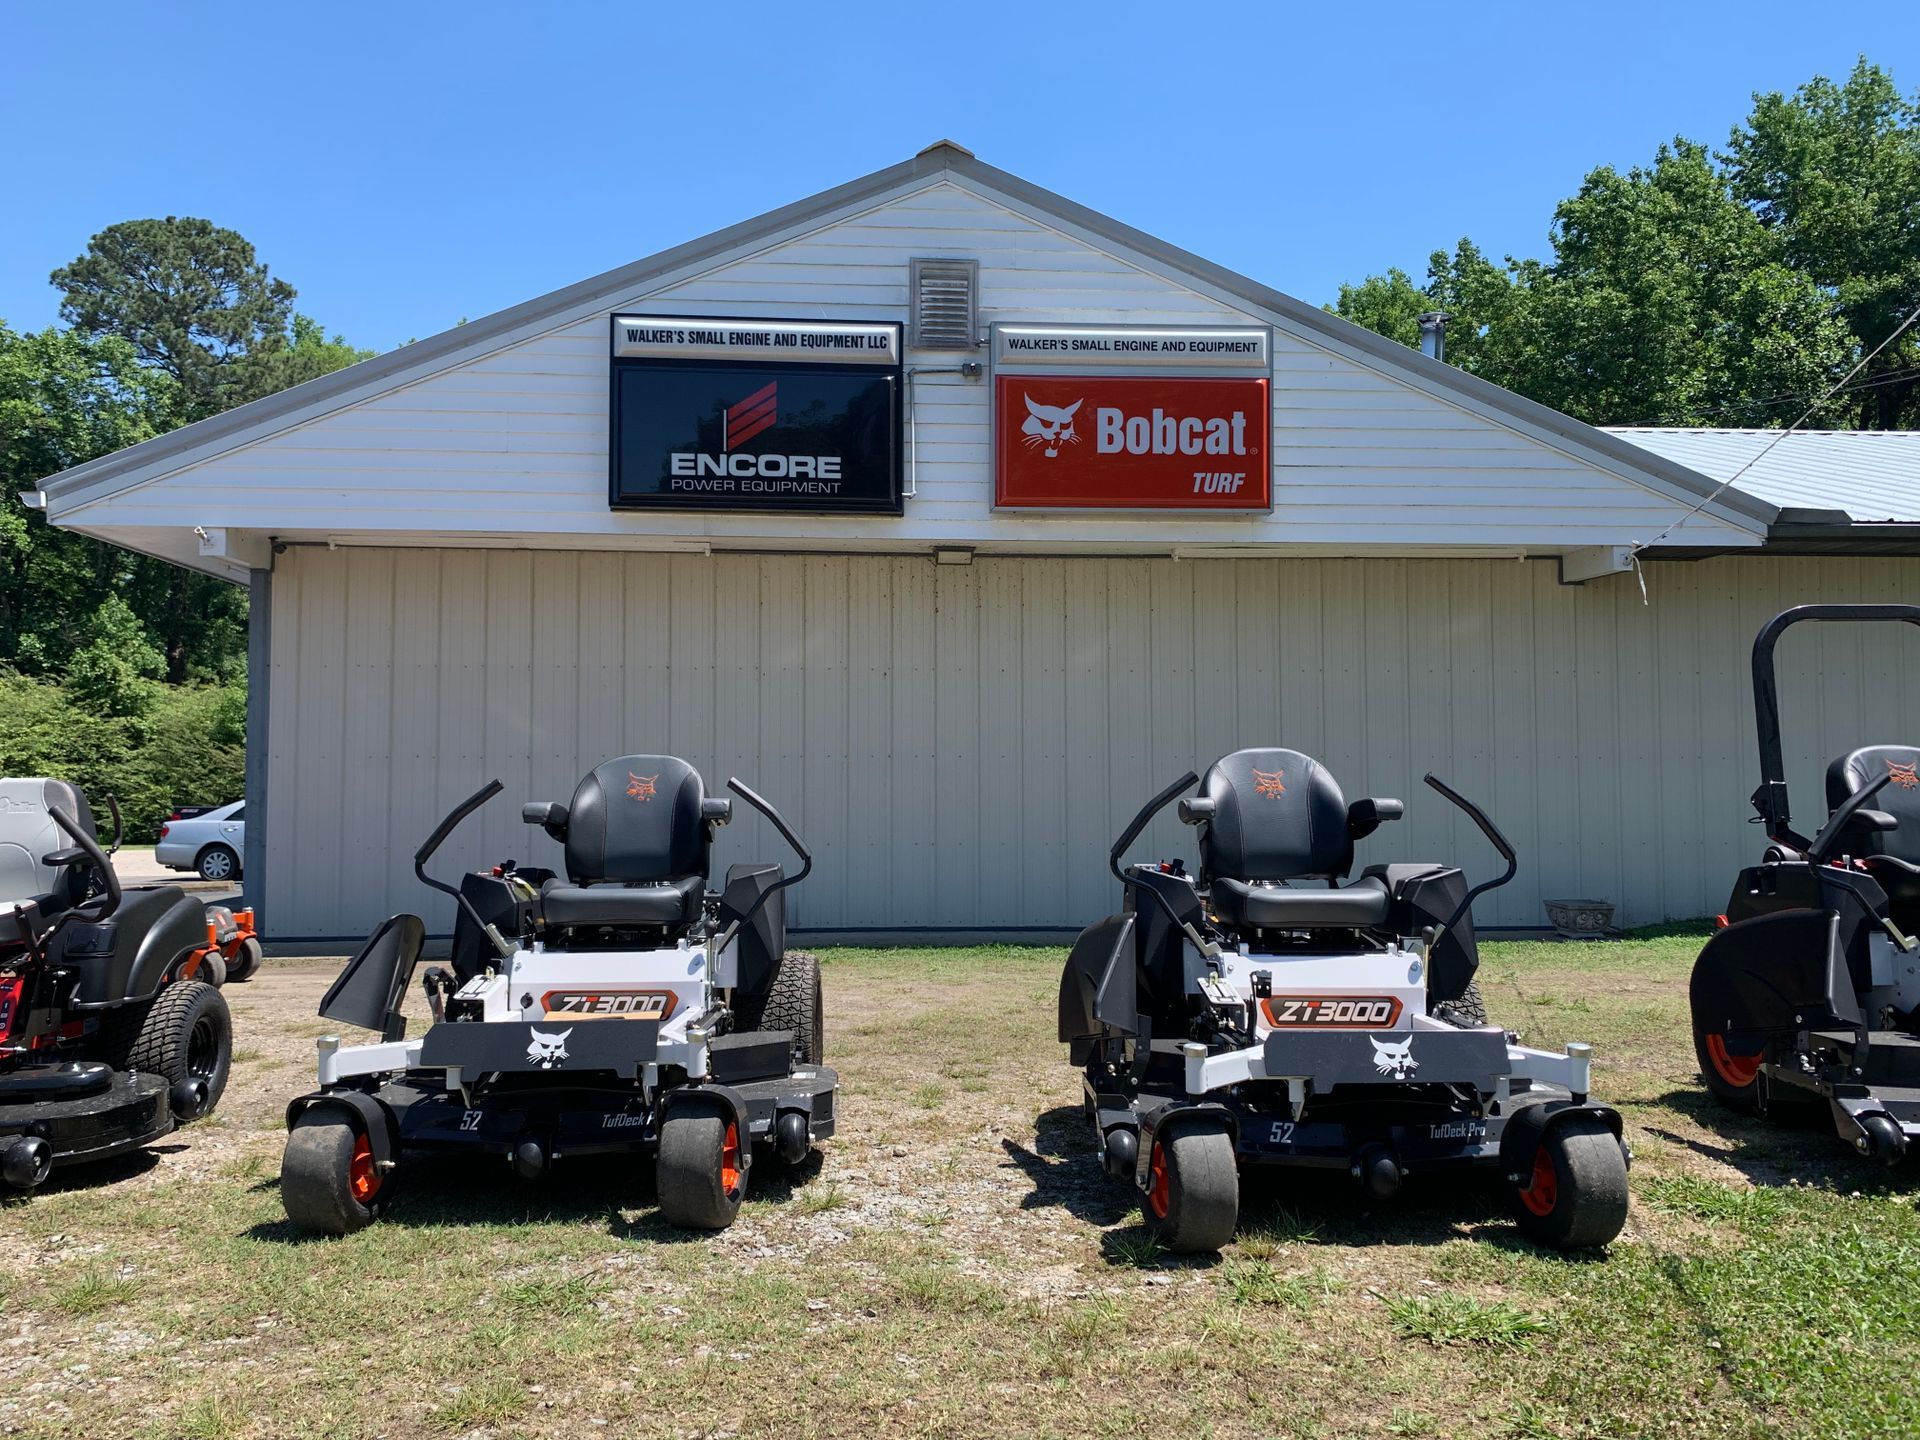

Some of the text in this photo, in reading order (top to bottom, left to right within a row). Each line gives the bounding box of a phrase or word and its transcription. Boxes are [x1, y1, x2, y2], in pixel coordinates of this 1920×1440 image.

[627, 329, 887, 349] WALKER'S SMALL ENGINE AND EQUIPMENT LLC
[1009, 339, 1258, 353] WALKER'S SMALL ENGINE AND EQUIPMENT
[1097, 407, 1246, 456] Bobcat
[671, 453, 842, 479] ENCORE
[671, 479, 842, 494] POWER EQUIPMENT
[1193, 472, 1246, 493] TURF
[560, 996, 667, 1013] ZT3000
[1278, 1001, 1391, 1021] ZT3000
[460, 1111, 483, 1131] 52
[602, 1112, 645, 1128] TufDeck
[1269, 1122, 1295, 1143] 52
[1430, 1122, 1485, 1139] TufDeck Pro
